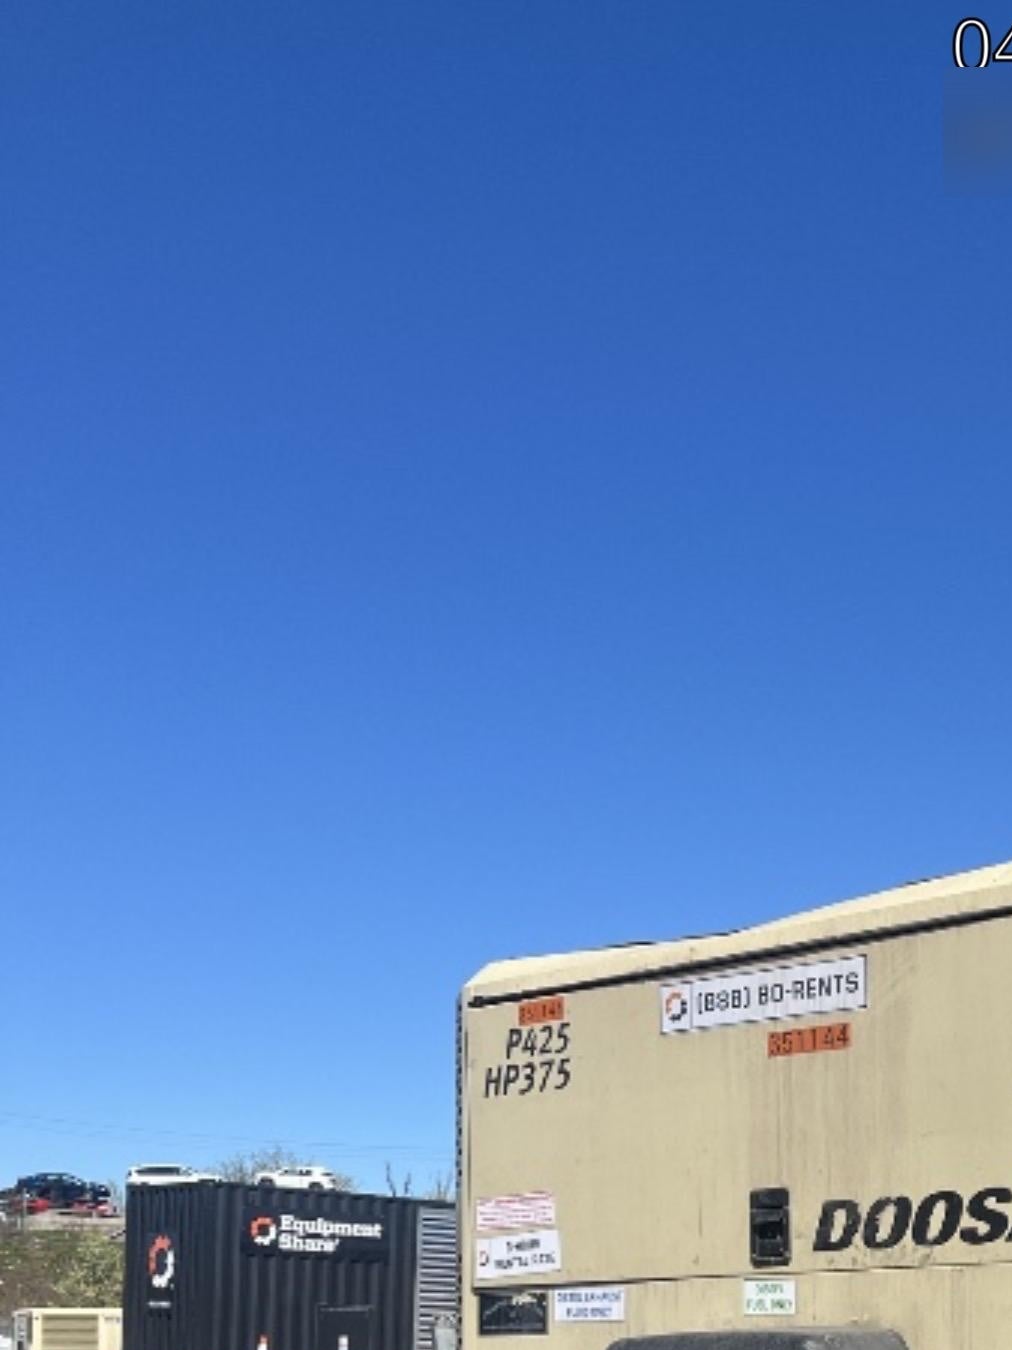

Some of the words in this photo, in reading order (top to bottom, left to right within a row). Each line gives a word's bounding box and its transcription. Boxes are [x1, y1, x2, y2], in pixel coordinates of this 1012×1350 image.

[506, 1022, 571, 1060] P425
[484, 1057, 571, 1098] HP375
[279, 1214, 382, 1238] Equipment
